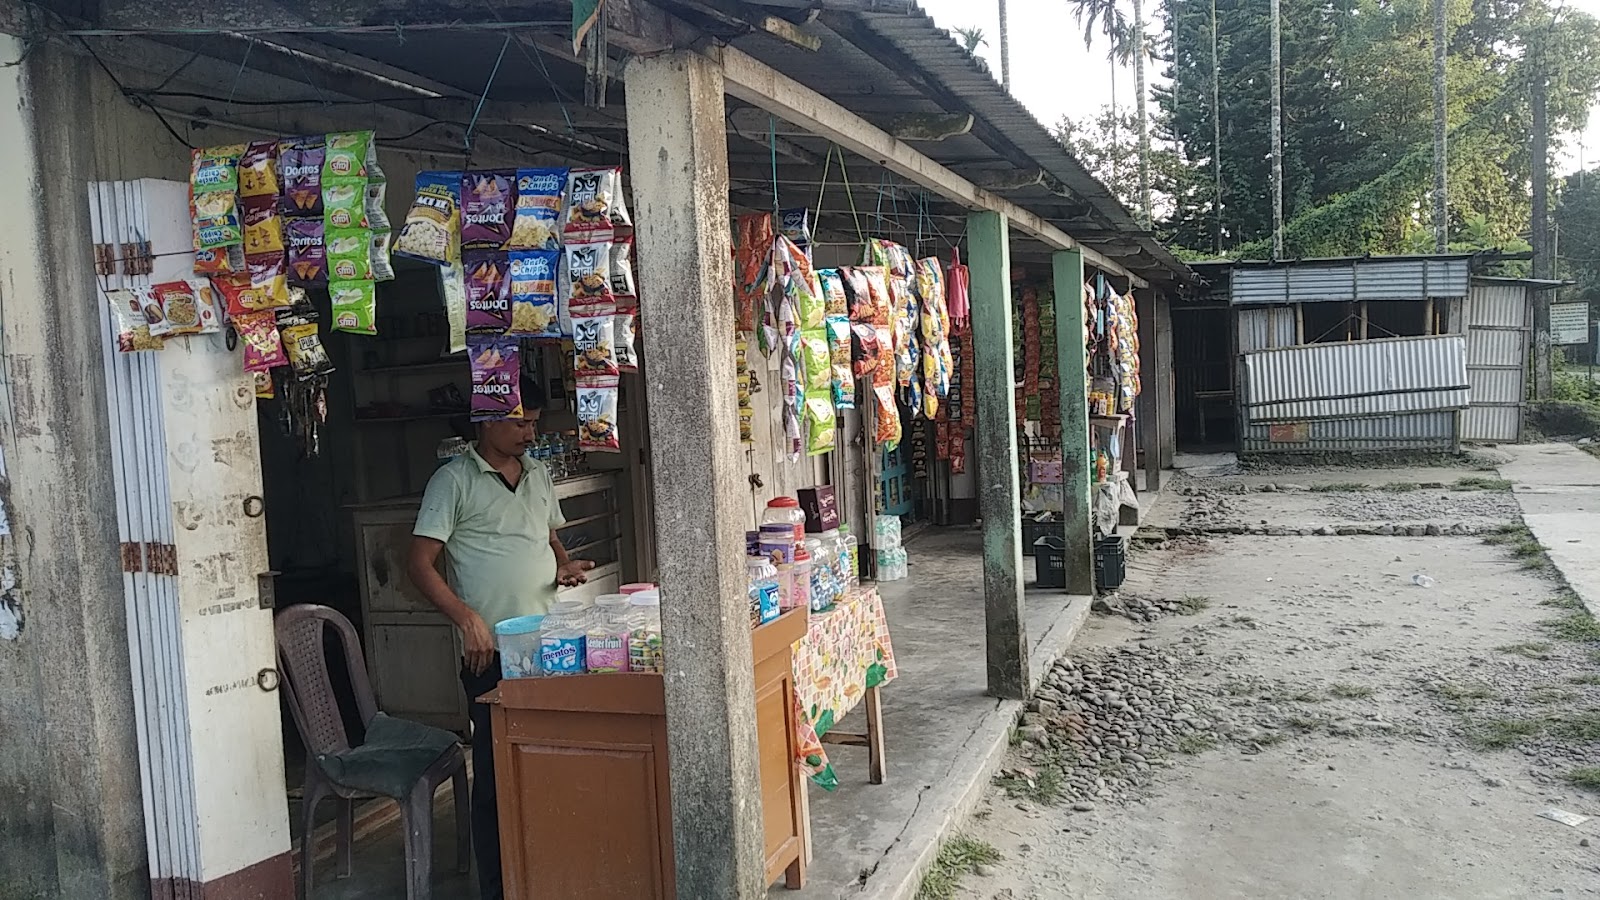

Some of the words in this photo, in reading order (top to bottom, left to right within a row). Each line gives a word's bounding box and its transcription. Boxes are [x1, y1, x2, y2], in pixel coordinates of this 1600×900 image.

[284, 164, 320, 177] Doritos
[197, 175, 222, 186] Uncle
[531, 173, 558, 183] Uncle
[528, 181, 559, 191] Chipps
[574, 179, 596, 192] ১৬
[572, 190, 596, 202] আনা
[466, 211, 504, 226] Doritos
[523, 256, 548, 266] Uncle
[571, 254, 593, 268] ১৬
[519, 265, 549, 275] Chipps
[569, 266, 593, 278] আনা
[470, 298, 509, 312] Doritos
[576, 327, 596, 341] ১৬
[573, 339, 597, 352] আনা
[472, 383, 510, 396] Doritos
[579, 398, 599, 412] ১৬
[604, 638, 623, 649] fruit
[541, 644, 577, 662] mentos
